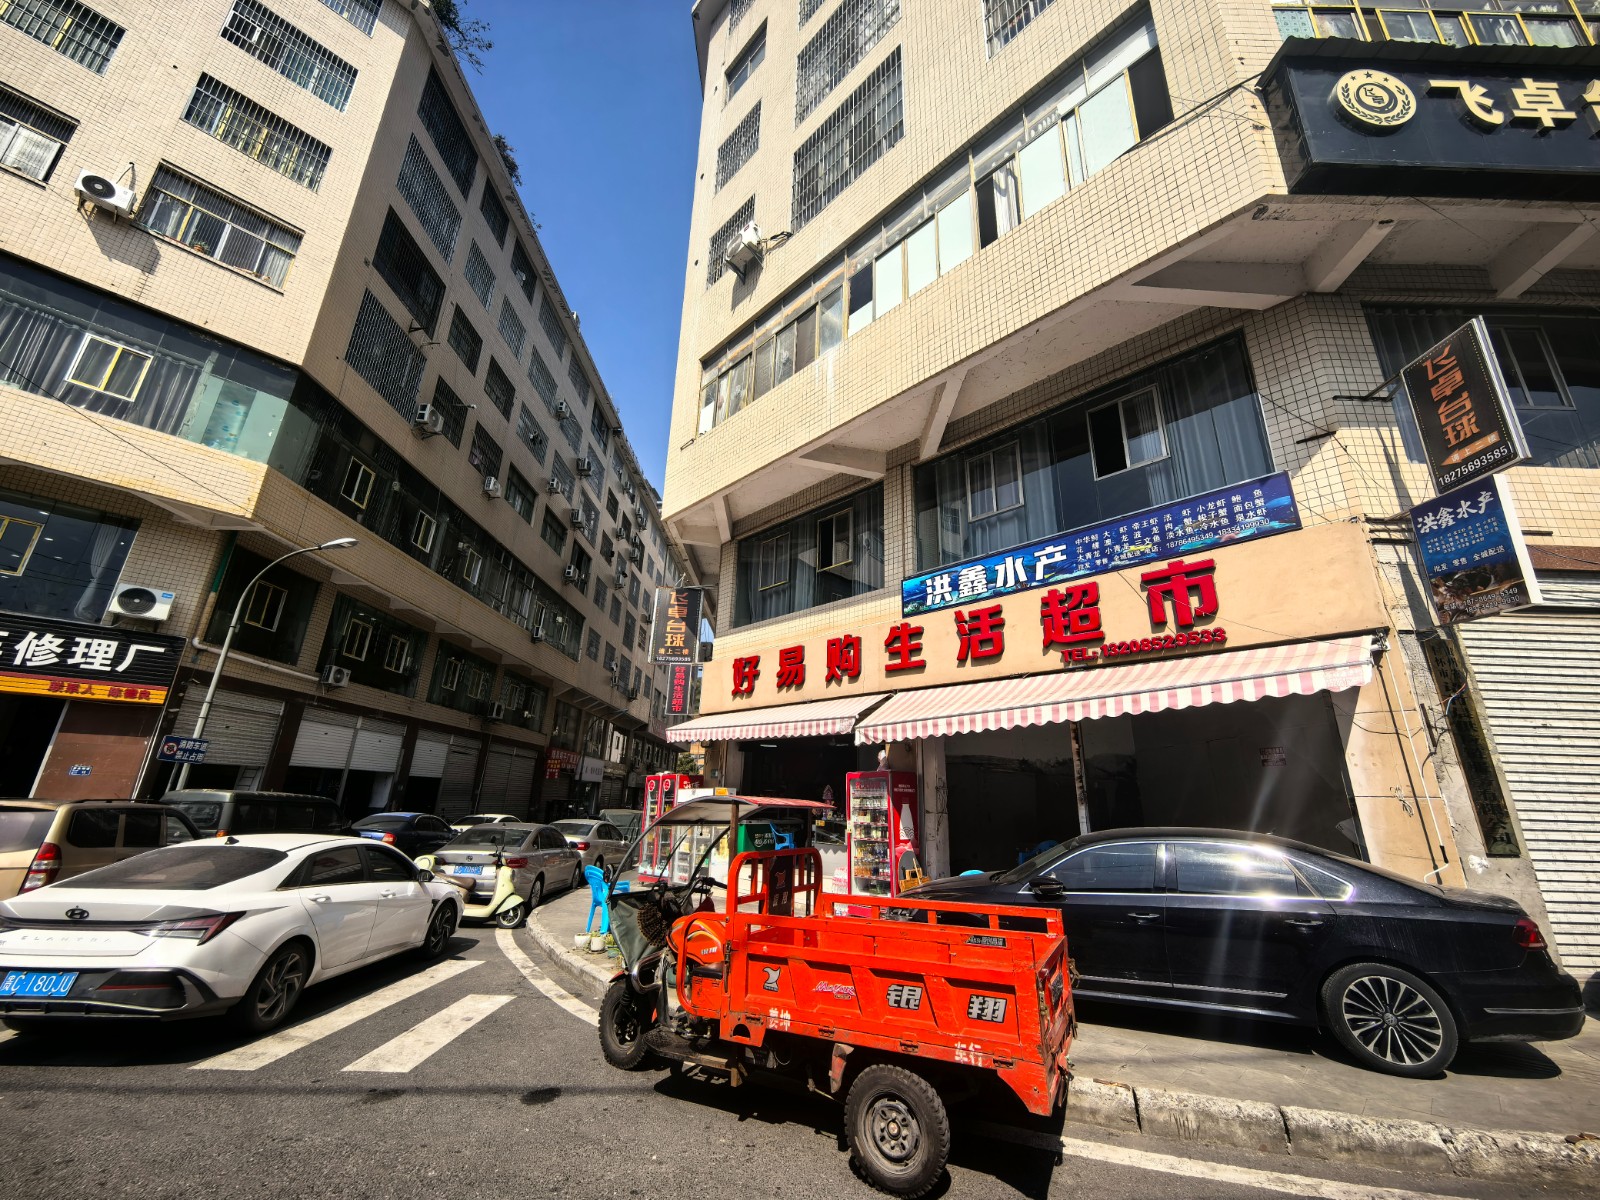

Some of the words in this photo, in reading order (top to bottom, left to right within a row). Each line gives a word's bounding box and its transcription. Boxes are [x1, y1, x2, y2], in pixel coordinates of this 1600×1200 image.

[1428, 78, 1600, 127] 飞卓
[1422, 344, 1481, 448] 飞卓台球
[1438, 445, 1508, 486] 18275693585
[1417, 491, 1494, 534] 洪鑫水产
[925, 544, 1067, 606] 洪鑫水产
[664, 591, 689, 647] 飞卓台球
[731, 558, 1218, 697] 好易购生活超市
[0, 631, 166, 673] 修理厂
[671, 666, 686, 712] 好易购生活超市
[175, 751, 204, 762] 禁止占用
[178, 739, 209, 752] 消防车道
